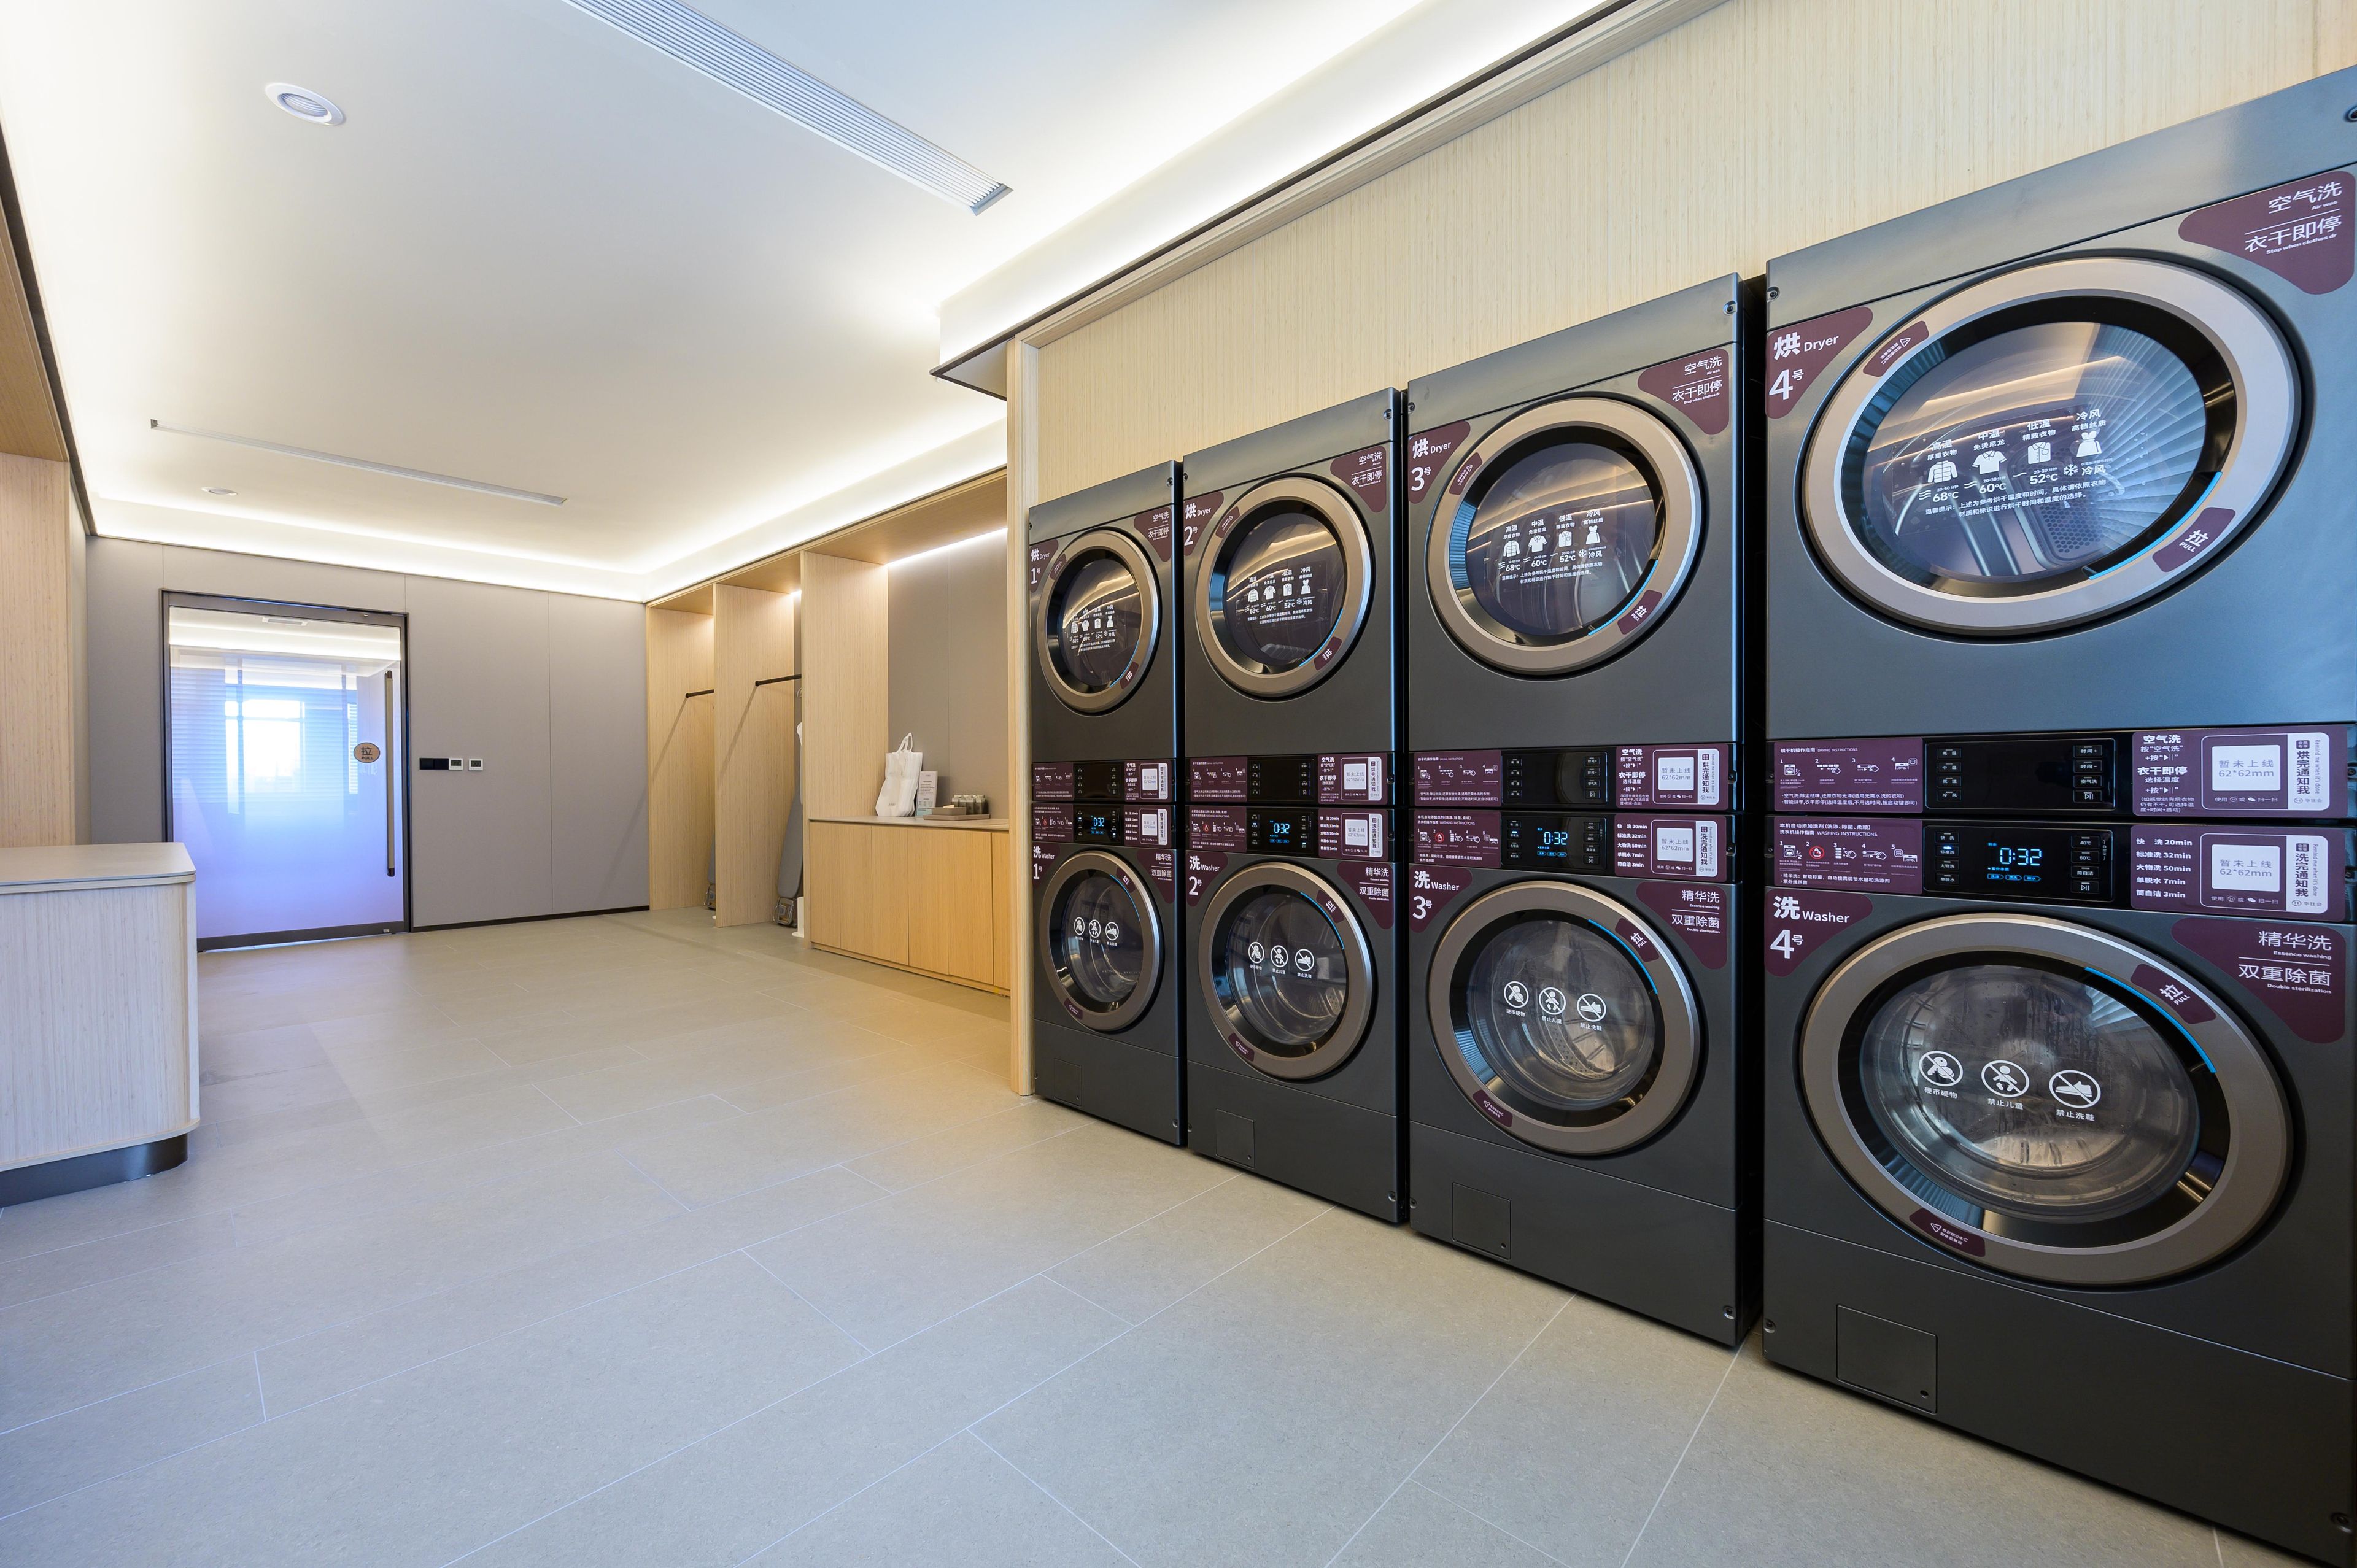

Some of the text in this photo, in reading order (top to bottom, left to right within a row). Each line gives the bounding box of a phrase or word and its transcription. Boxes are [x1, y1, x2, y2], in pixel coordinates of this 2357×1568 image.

[2269, 182, 2342, 214] 空气洗
[2244, 215, 2342, 252] 衣干即停
[2302, 236, 2328, 246] clothes
[1773, 331, 1839, 360] 烘 Dryer
[1684, 355, 1722, 376] 空气洗
[1672, 379, 1722, 403] 衣干即停
[2076, 409, 2101, 421] 冷风
[2027, 418, 2051, 431] 低温
[2071, 419, 2107, 432] 高档丝质
[1978, 429, 2000, 441] 中温
[2022, 429, 2056, 441] 精致衣物
[1412, 438, 1451, 459] 烘 Dryer
[1931, 439, 1953, 451] 高温
[1973, 439, 2005, 451] 免烫尼龙
[1358, 450, 1382, 465] 空气洗
[1927, 449, 1957, 461] 厚重衣物
[2081, 464, 2106, 476] 冷风
[1352, 470, 1382, 485] 衣干即停
[1153, 511, 1169, 522] 空气洗
[1185, 503, 1211, 520] 烘 Dryer
[1559, 514, 1572, 522] 低温
[1148, 527, 1169, 538] 衣干即停
[2185, 530, 2209, 547] 拉
[2179, 541, 2196, 552] PULL
[1031, 548, 1039, 562] 烘
[1631, 613, 1640, 622] PULL
[1635, 605, 1647, 618] 拉
[2143, 735, 2181, 744] 空气洗
[361, 746, 372, 755] 拉
[2219, 759, 2274, 768] 暂未上线
[2137, 766, 2188, 776] 衣干即停
[2297, 751, 2310, 795] 烘完通知我
[1093, 817, 1104, 827] 0:32
[1274, 823, 1290, 834] 0:32
[1544, 832, 1568, 845] 0:32
[1033, 846, 1041, 859] 洗
[1156, 853, 1172, 862] 精华洗
[2000, 848, 2042, 866] 0:32
[1189, 855, 1201, 870] 洗
[2220, 859, 2272, 868] 暂未上线
[1151, 869, 1172, 878] 双重除菌
[1365, 867, 1389, 877] 精华洗
[2296, 853, 2309, 897] 洗完通知我
[1414, 870, 1460, 891] 洗 Washer
[1359, 886, 1389, 897] 双重除菌
[1682, 890, 1720, 903] 精华洗
[1773, 895, 1850, 923] 洗 Washer
[1671, 914, 1720, 928] 双重除菌
[1630, 933, 1643, 944] 拉
[2258, 930, 2332, 951] 精华洗
[2238, 964, 2331, 986] 双重除菌
[2159, 984, 2183, 1000] 拉
[2173, 994, 2191, 1005] PULL
[1924, 1087, 1957, 1099] 硬币硬物
[1987, 1098, 2024, 1110] 禁止儿童
[2056, 1109, 2095, 1122] 禁止洗鞋
